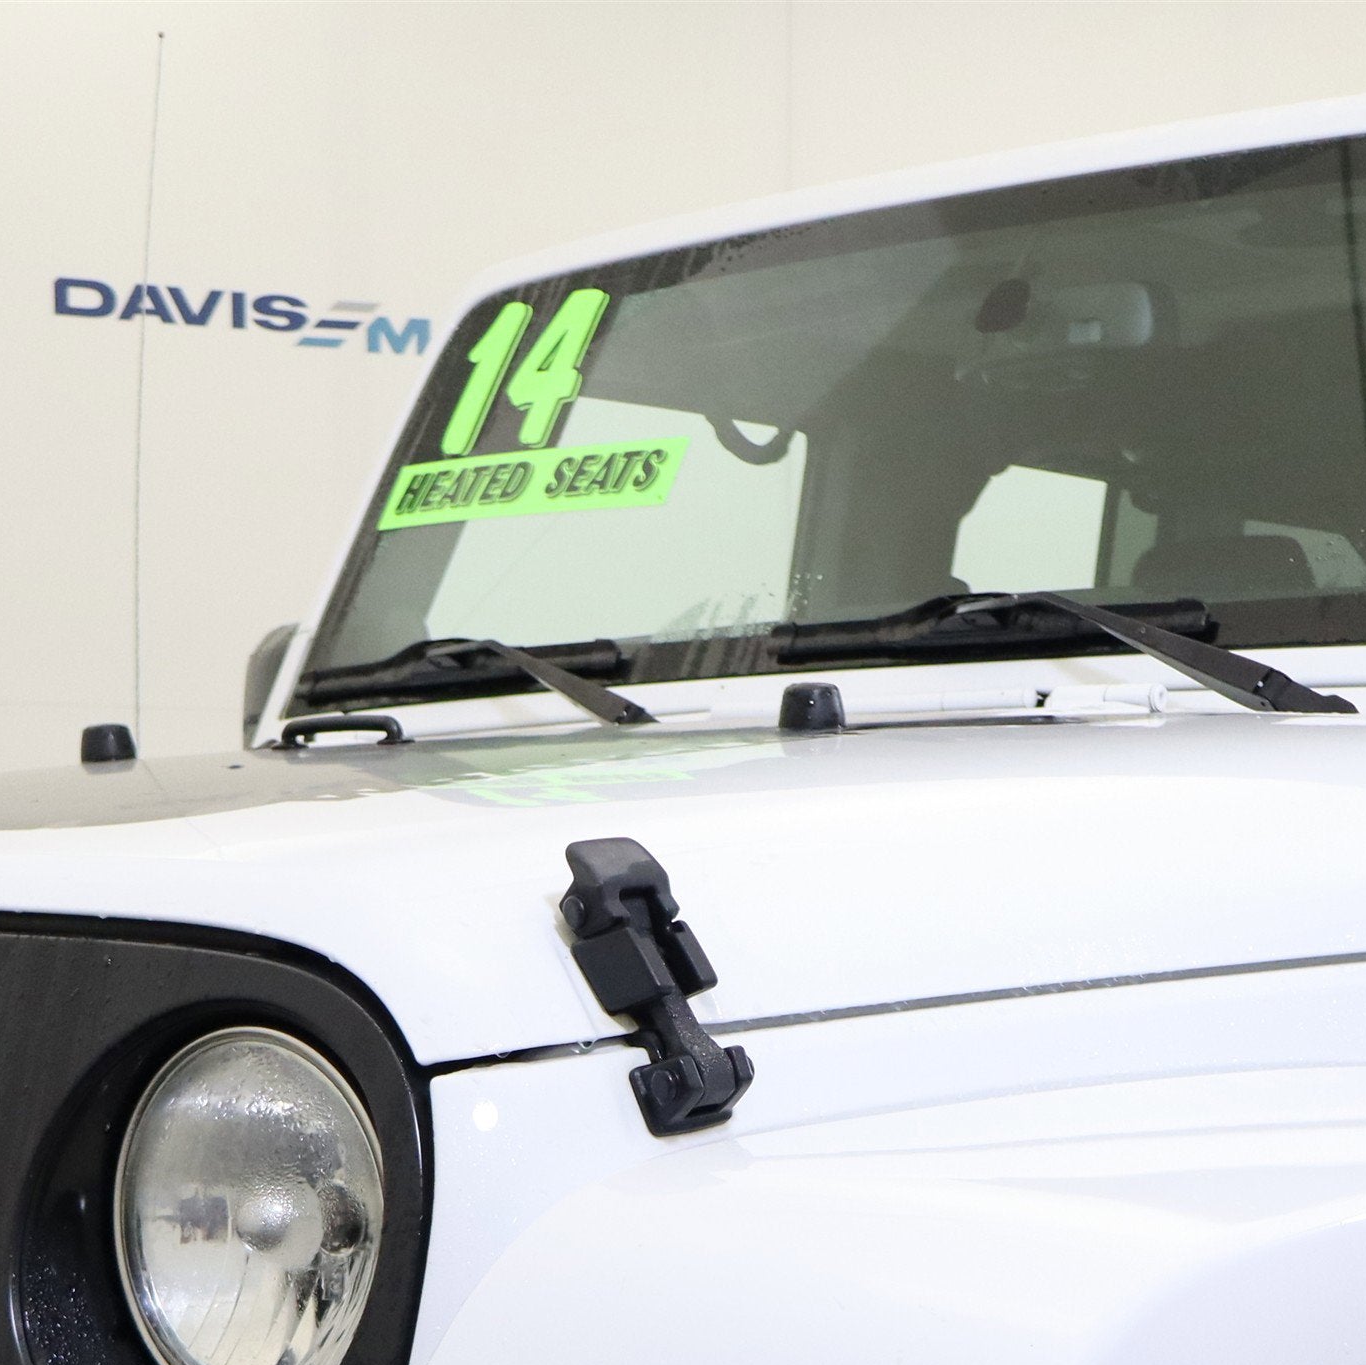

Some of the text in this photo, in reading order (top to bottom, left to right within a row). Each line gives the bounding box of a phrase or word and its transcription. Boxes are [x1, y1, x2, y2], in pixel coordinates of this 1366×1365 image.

[53, 276, 309, 332] DAVIS
[440, 288, 610, 457] 14
[395, 449, 668, 515] HEATED SEATS
